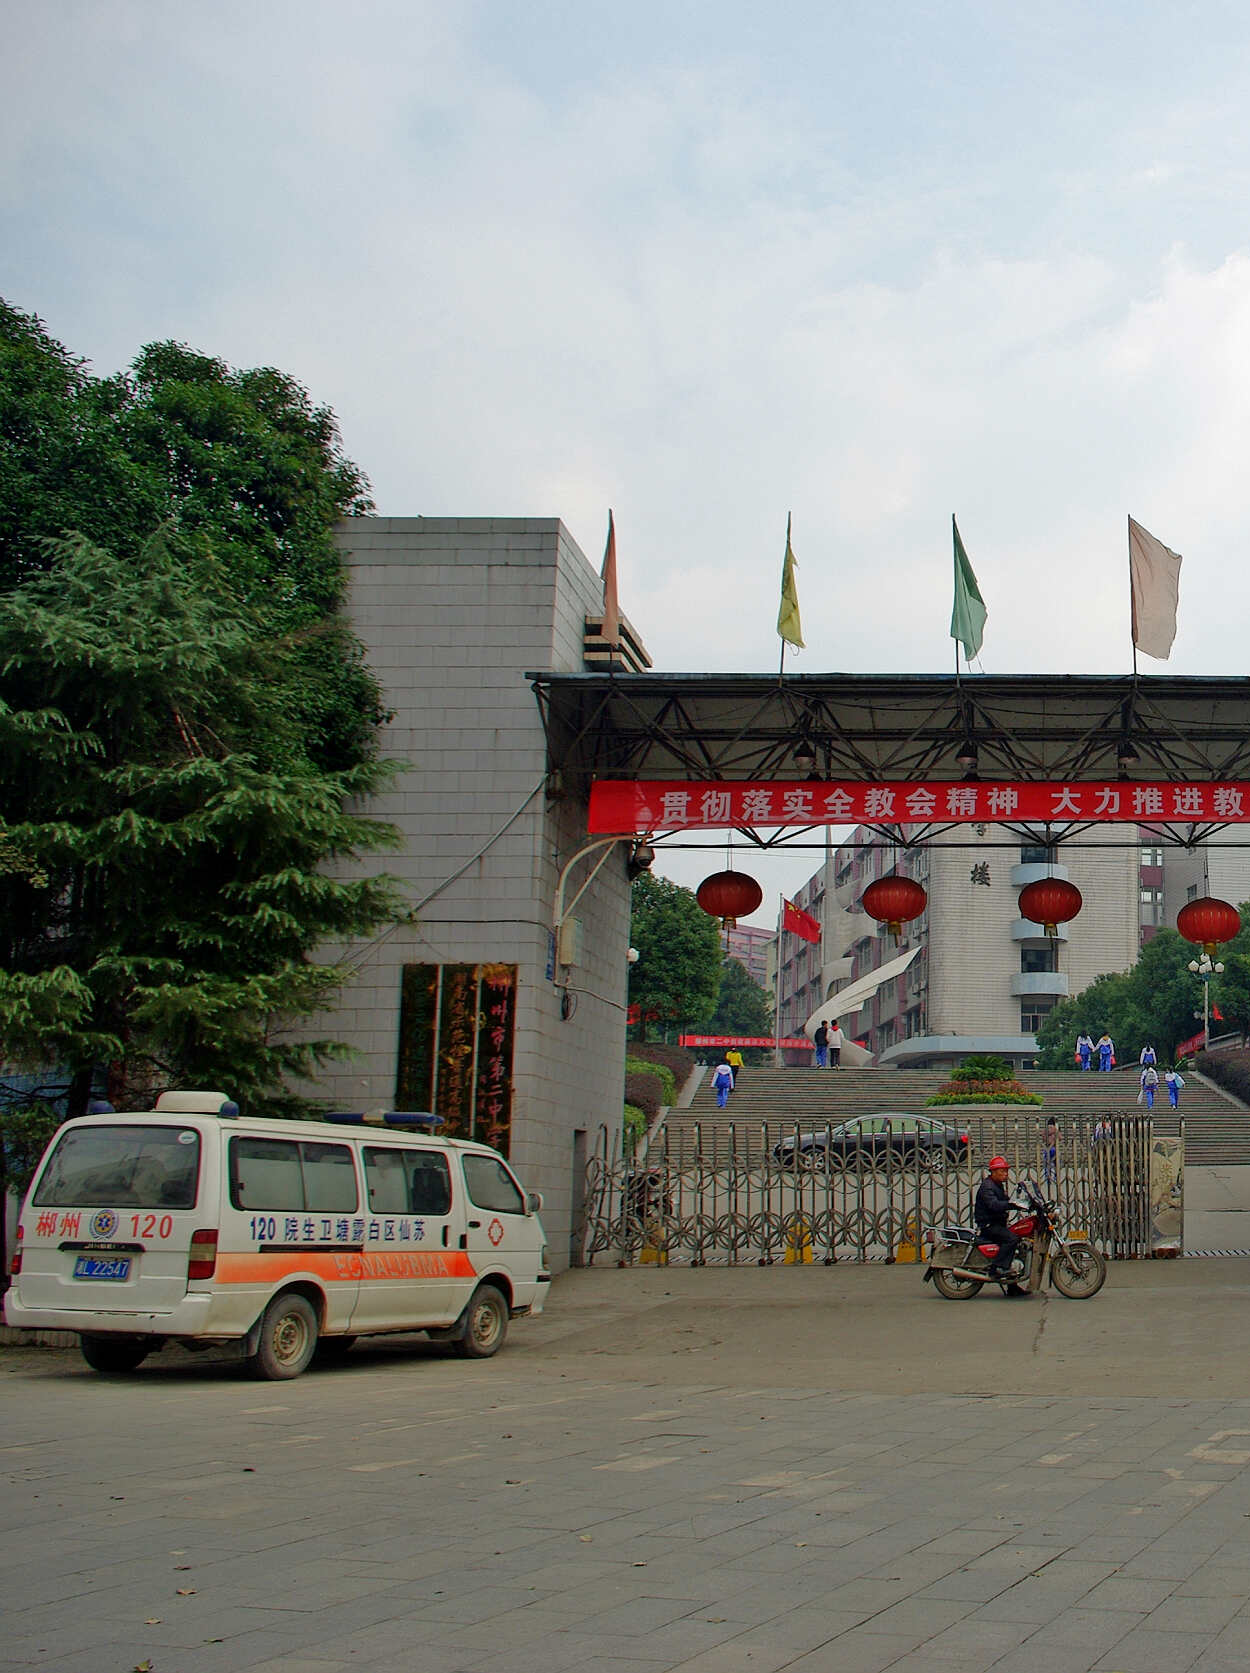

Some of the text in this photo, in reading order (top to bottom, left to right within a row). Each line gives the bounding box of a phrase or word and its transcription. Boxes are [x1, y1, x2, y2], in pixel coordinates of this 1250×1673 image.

[659, 787, 1019, 824] 贯彻落实全教会精神
[36, 1211, 173, 1239] 郴州 120
[250, 1216, 276, 1241] 120
